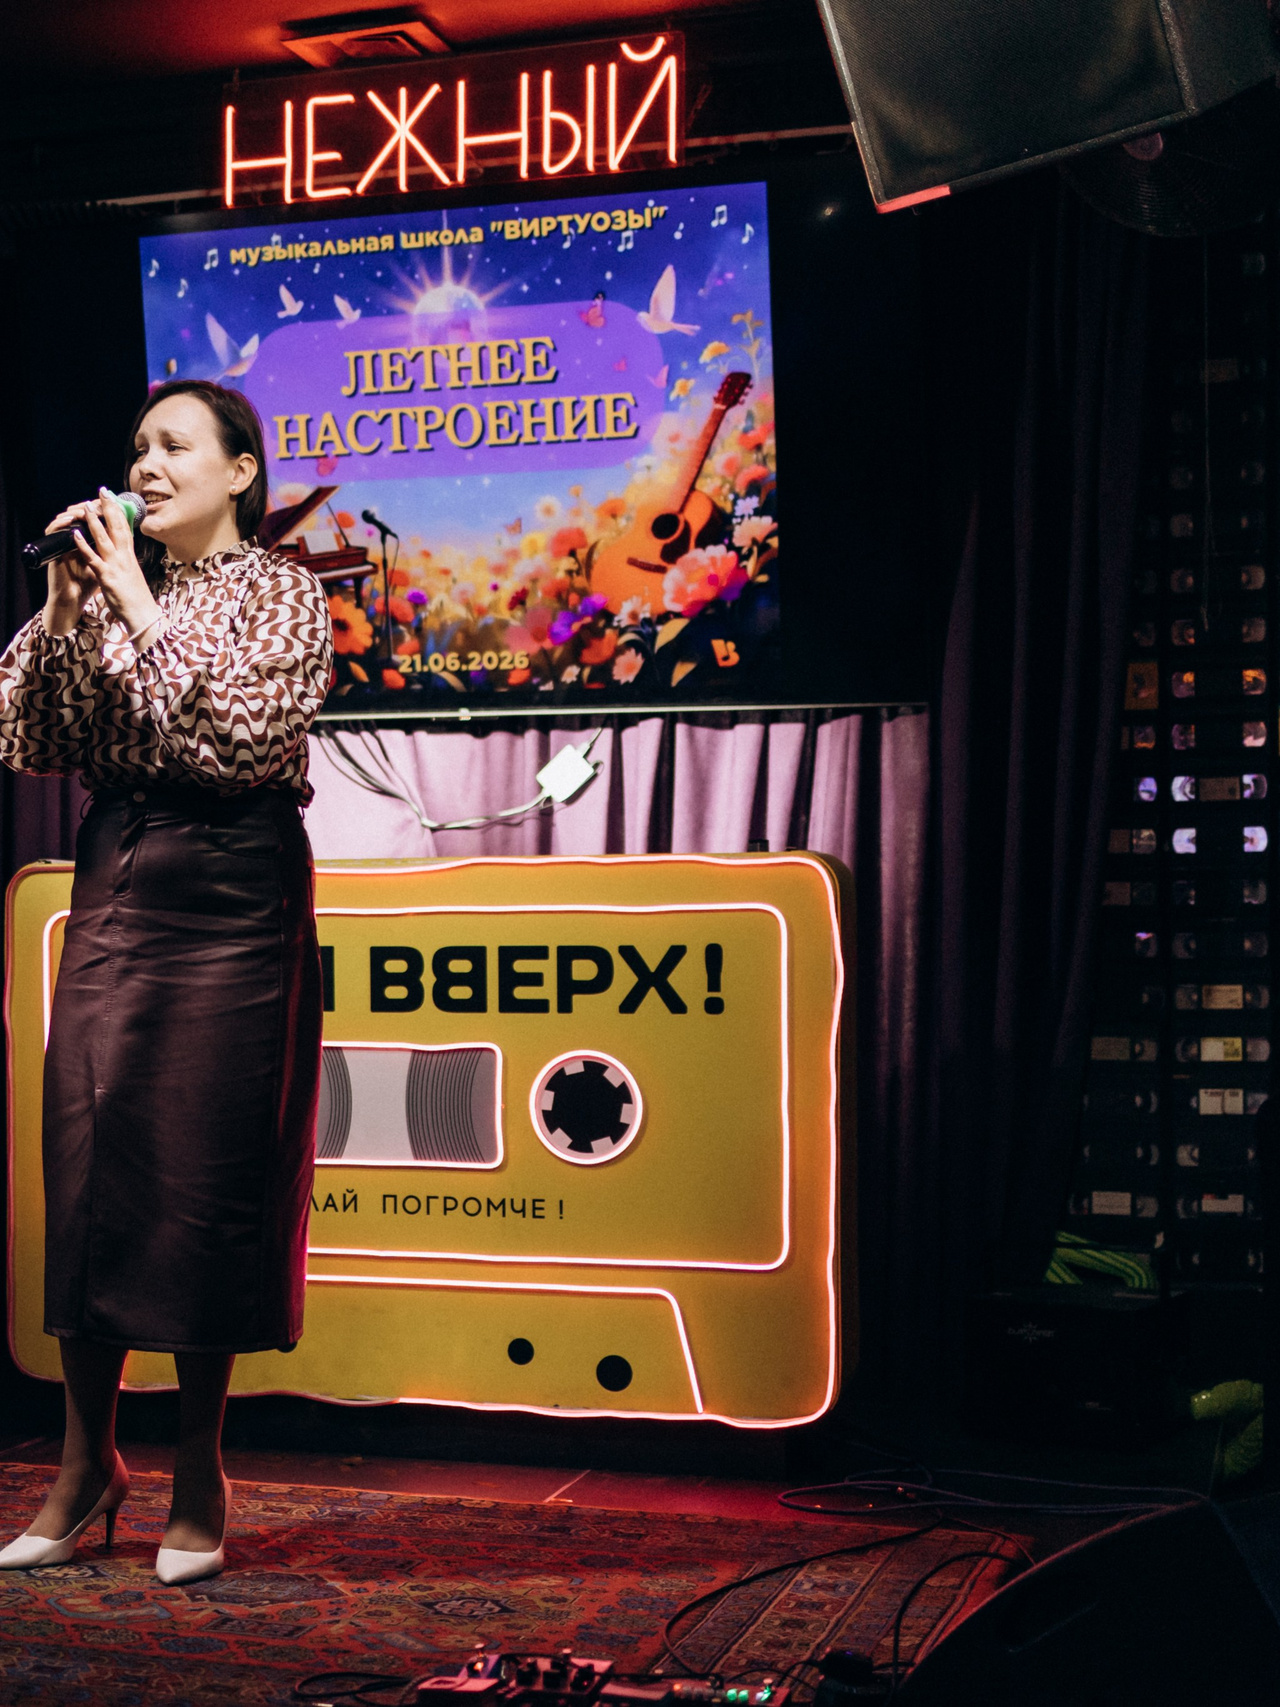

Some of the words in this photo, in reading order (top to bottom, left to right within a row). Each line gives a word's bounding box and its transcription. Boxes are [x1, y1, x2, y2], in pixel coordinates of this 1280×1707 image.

[224, 36, 678, 208] НЕЖНЫЙ
[229, 232, 396, 265] музыкальная
[400, 226, 485, 251] школа
[490, 206, 668, 242] "ВИРТУОЗЫ"
[341, 335, 559, 397] ЛЕТНЕЕ
[272, 392, 639, 460] НАСТРОЕНИЕ
[398, 649, 531, 674] 21.06.2026
[369, 942, 726, 1016] ВВЕРХ!
